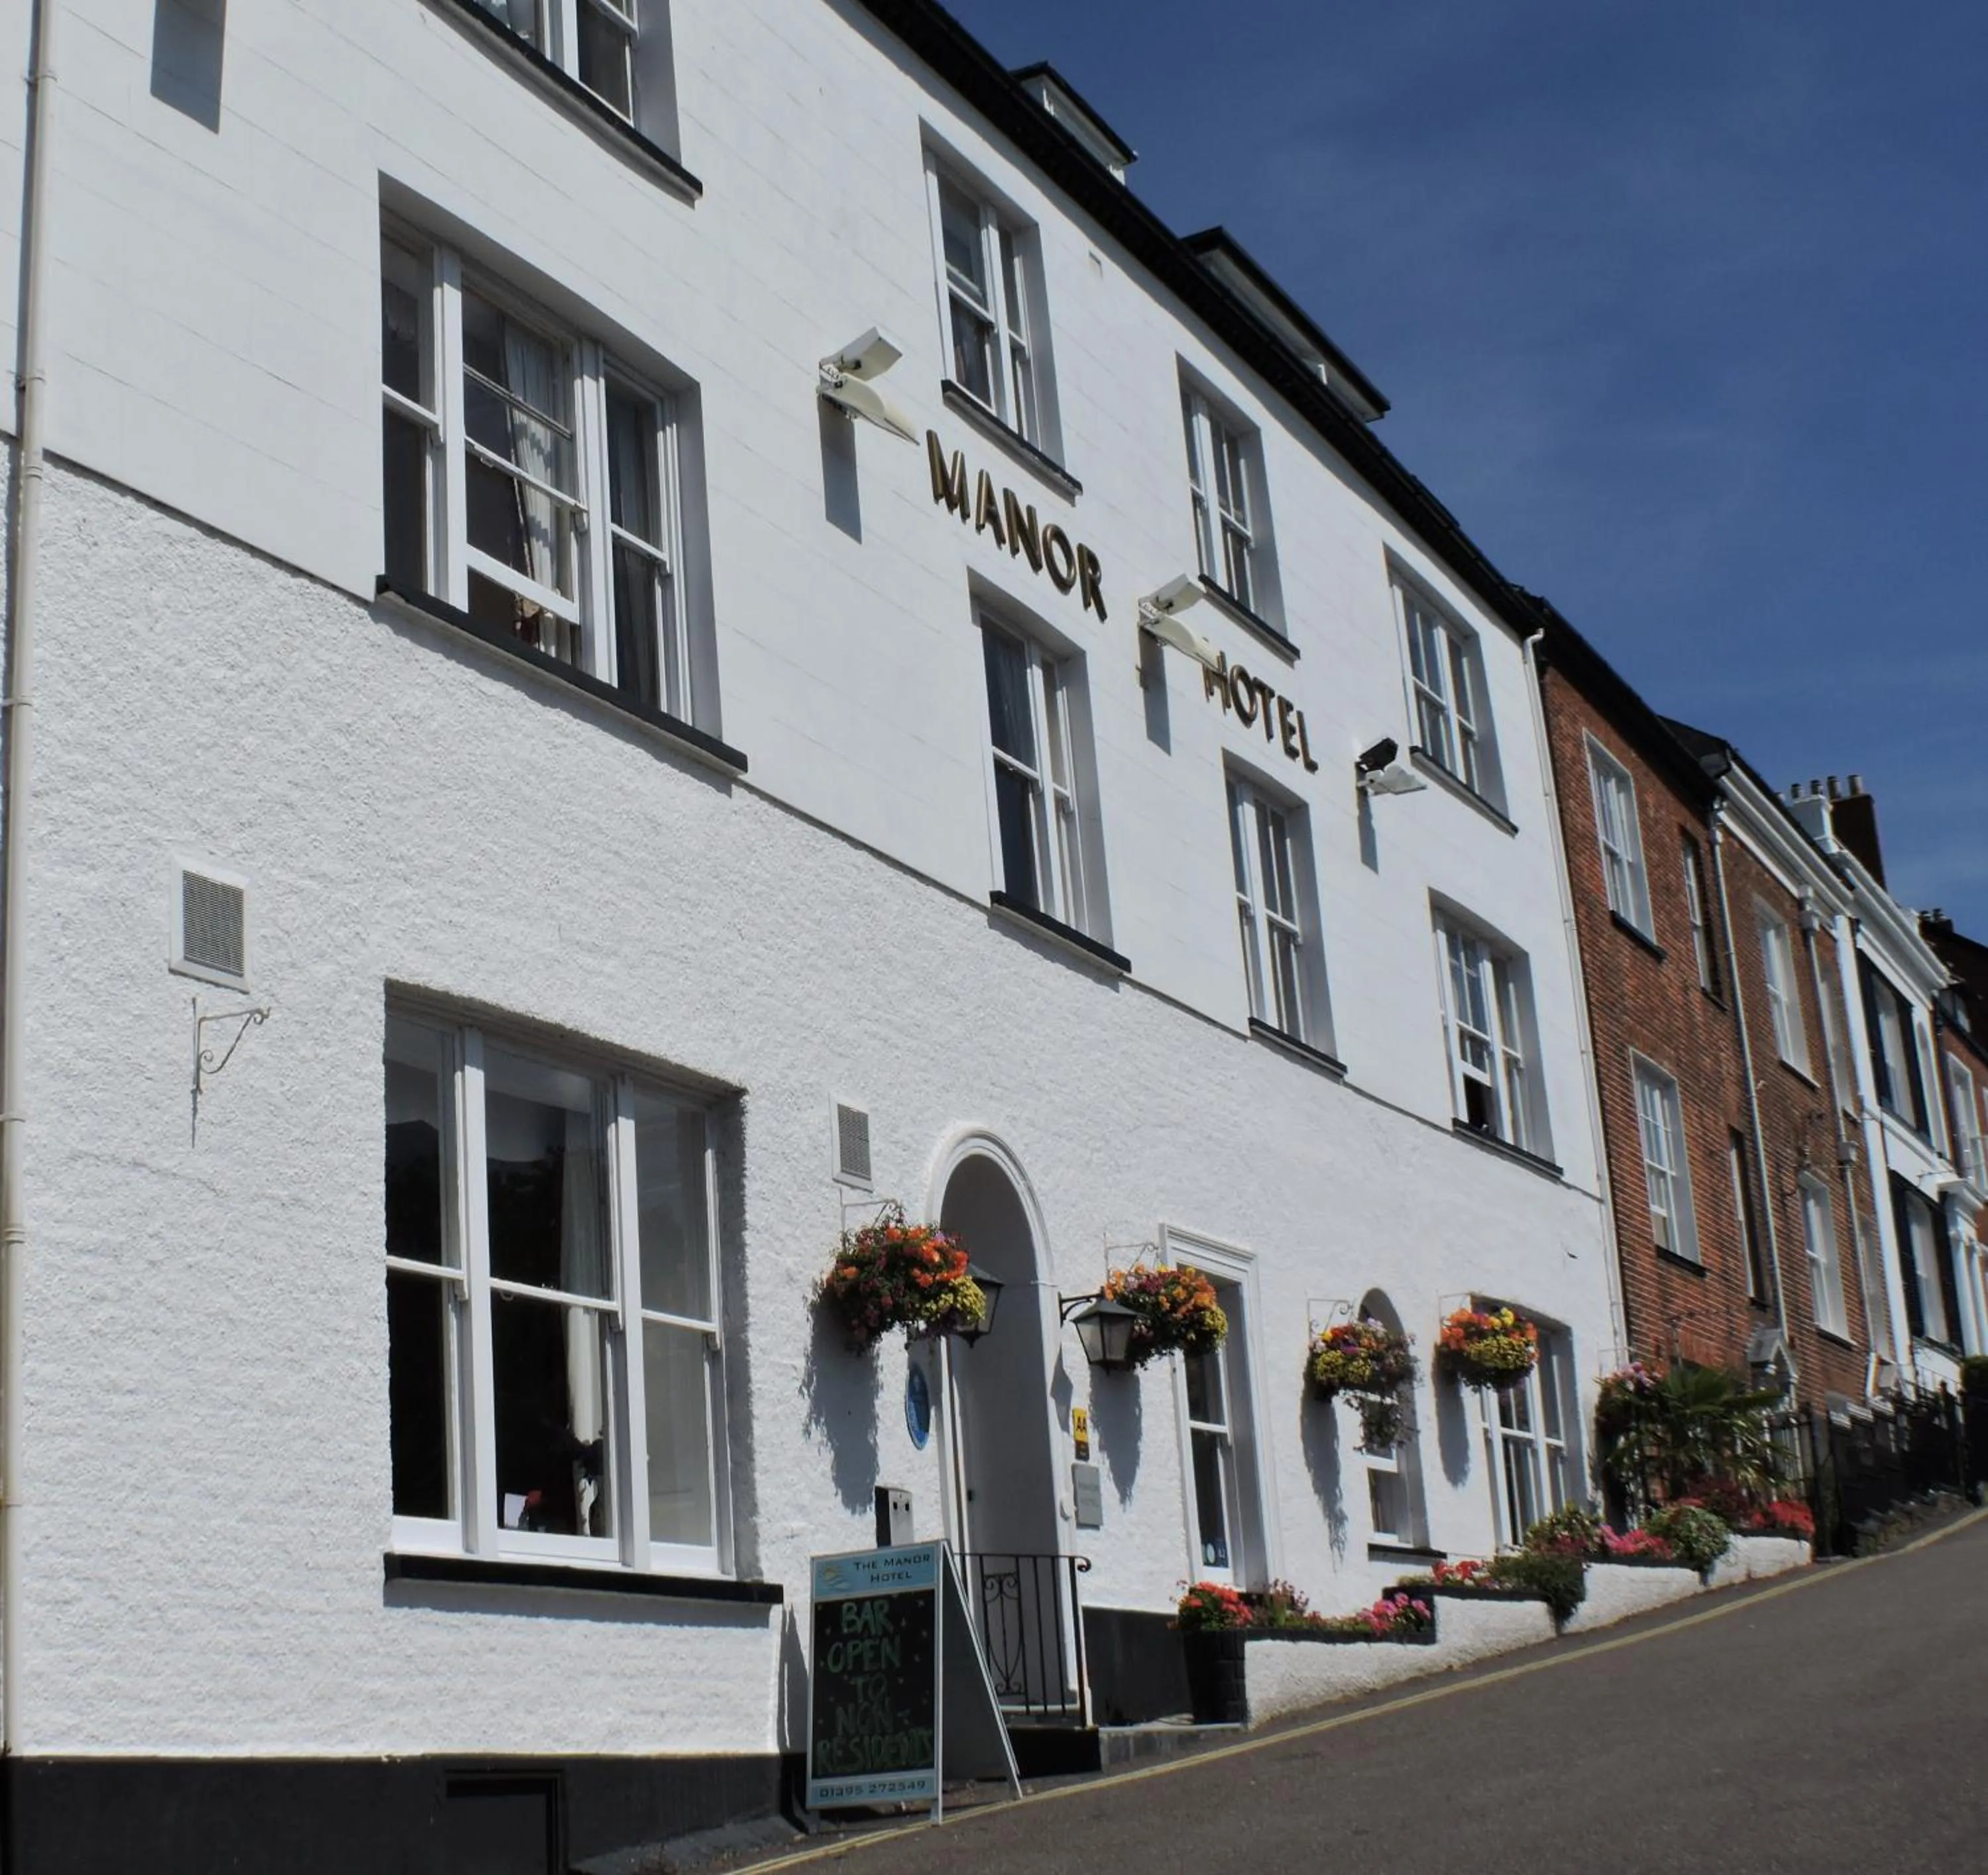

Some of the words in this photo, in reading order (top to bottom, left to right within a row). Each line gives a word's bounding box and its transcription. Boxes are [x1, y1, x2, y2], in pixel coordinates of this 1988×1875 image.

[926, 429, 1107, 623] MANOR
[1202, 650, 1319, 775] HOTEL
[1076, 1415, 1086, 1432] AA
[854, 1561, 877, 1571] THE
[883, 1554, 930, 1568] MANOR
[870, 1570, 912, 1583] HOTEL
[842, 1599, 895, 1635] BAR
[827, 1632, 902, 1674] OPEN
[848, 1672, 888, 1703] TO
[819, 1786, 864, 1798] 01395
